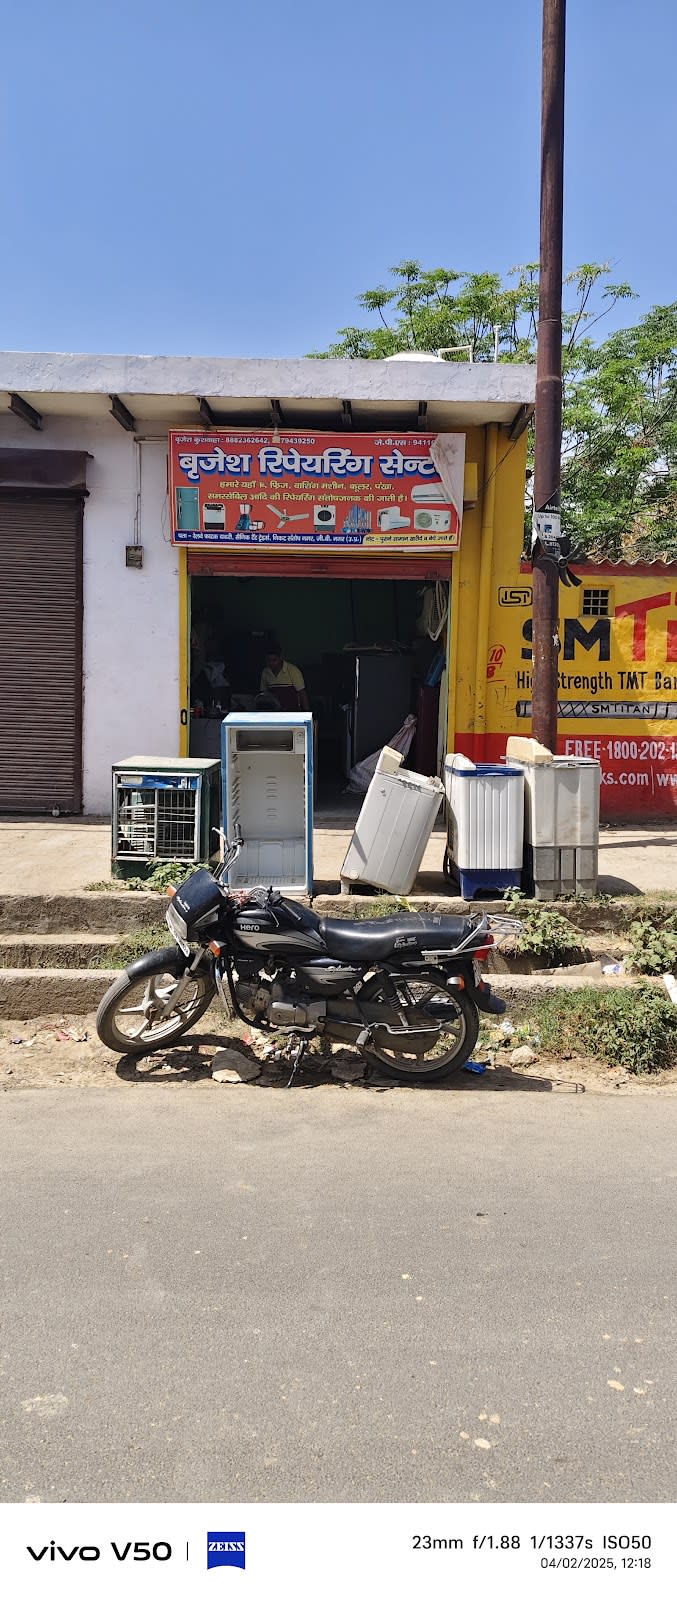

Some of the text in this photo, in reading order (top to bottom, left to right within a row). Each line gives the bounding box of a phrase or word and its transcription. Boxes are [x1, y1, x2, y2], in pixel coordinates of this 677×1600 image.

[179, 446, 441, 483] बृजेश रिपेयरिंग सेन्ट
[618, 672, 648, 690] TMT
